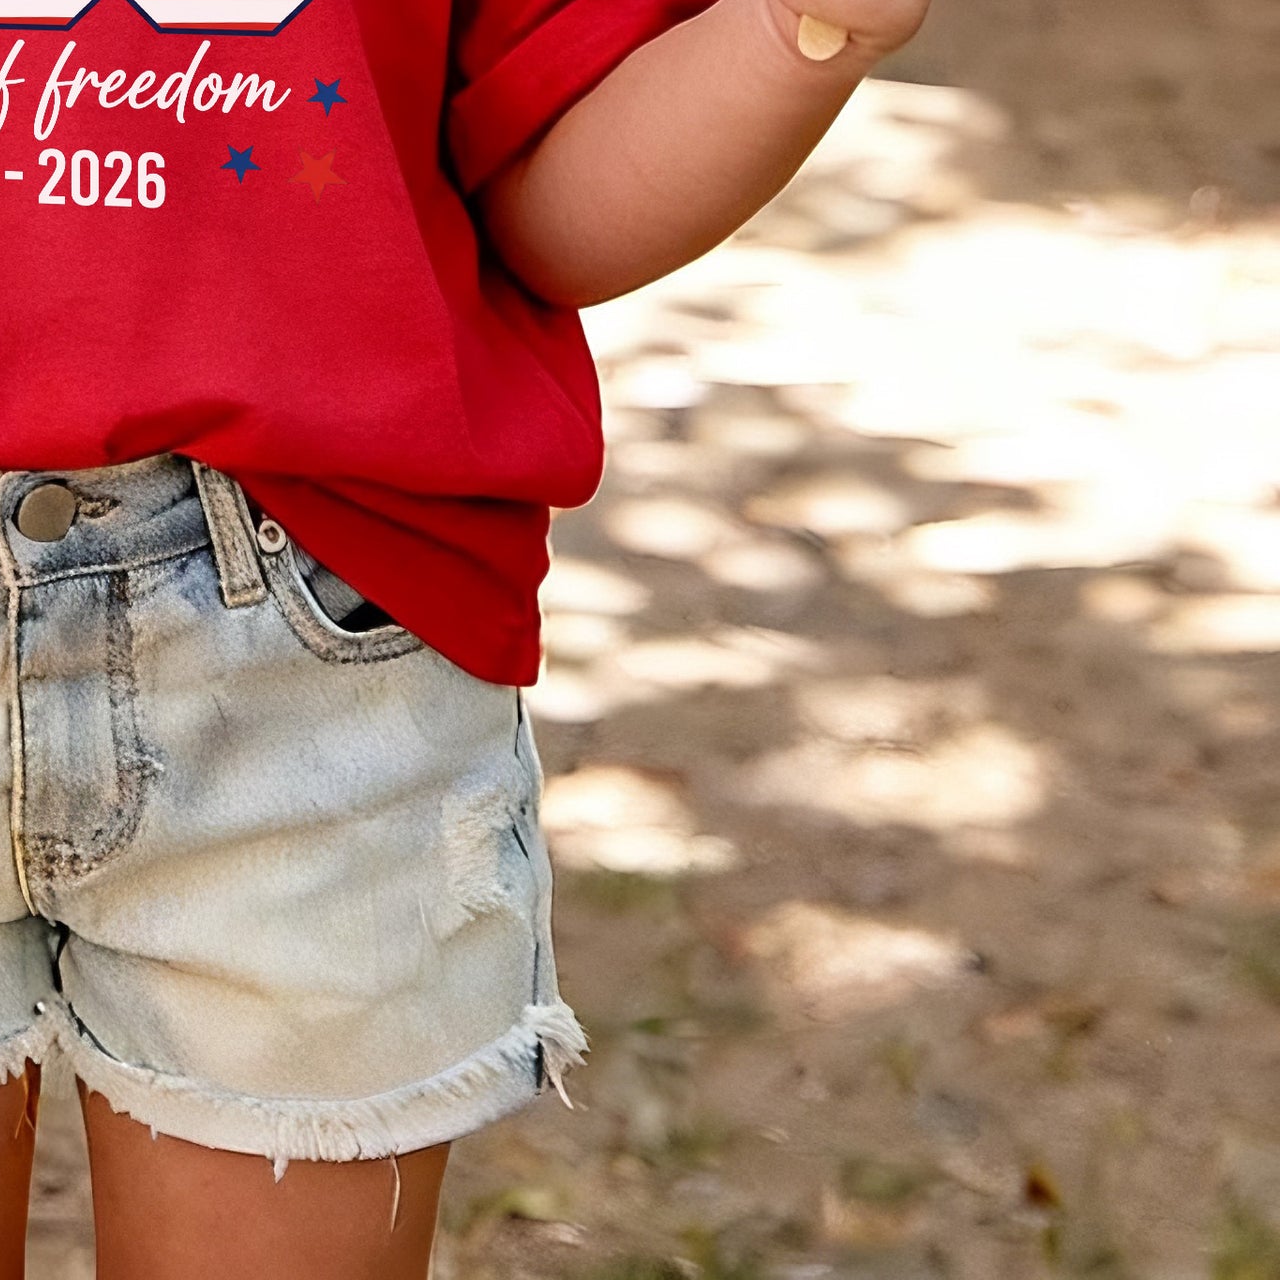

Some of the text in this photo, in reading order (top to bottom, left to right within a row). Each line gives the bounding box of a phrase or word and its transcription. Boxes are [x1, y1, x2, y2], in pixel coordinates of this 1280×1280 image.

[33, 41, 291, 140] freedom
[4, 172, 24, 180] -
[38, 147, 166, 208] 2026
